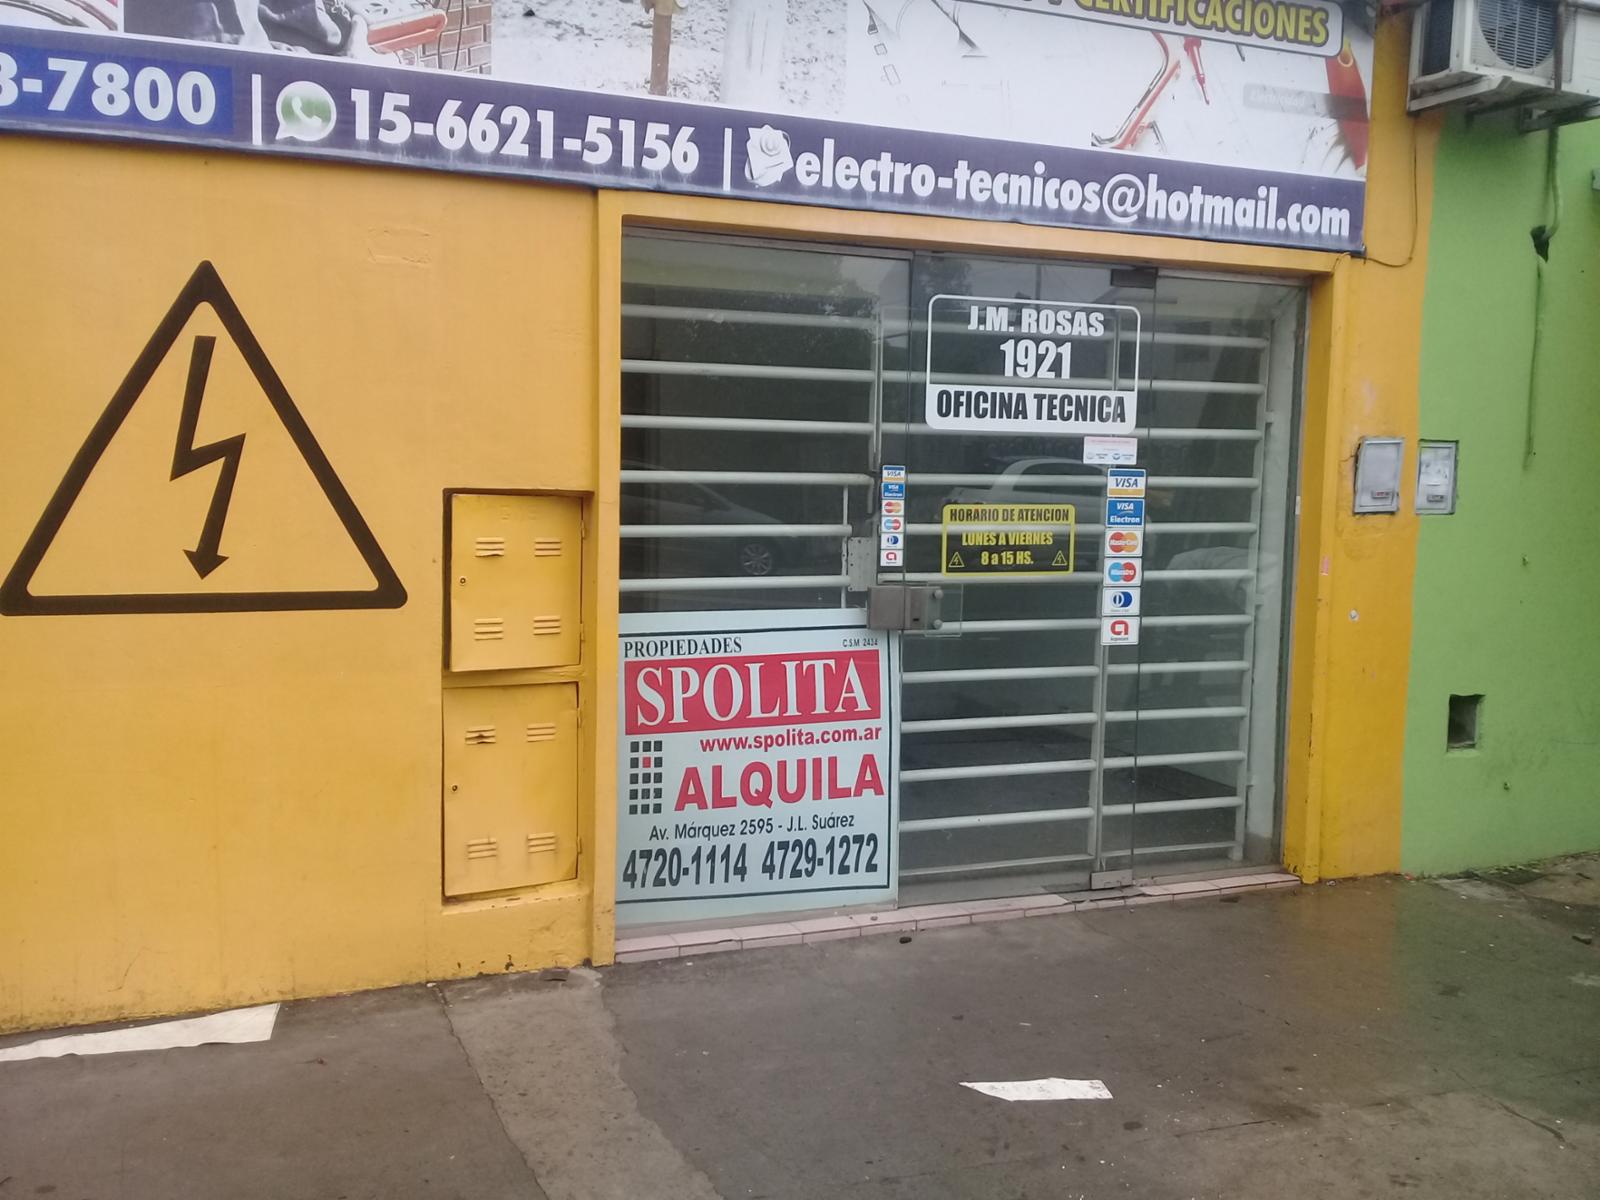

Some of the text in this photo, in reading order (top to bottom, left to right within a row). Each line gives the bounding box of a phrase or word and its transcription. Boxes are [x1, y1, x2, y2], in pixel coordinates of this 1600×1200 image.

[350, 88, 700, 175] 15-6621-5156
[795, 138, 1350, 237] electro-tecnicos@hotmail.com
[967, 305, 1105, 337] J.M. ROSAS
[1000, 339, 1072, 380] 1921
[936, 389, 1126, 423] OFICINA TECNICA
[1115, 478, 1138, 488] VISA
[950, 508, 1069, 522] HORARIO DE ATENCION
[1110, 515, 1140, 523] Electron
[1116, 502, 1134, 510] VISA
[962, 531, 1054, 546] LUNES A VIERNES
[981, 551, 1034, 565] 8 a 15 HS.
[624, 637, 742, 658] PROPIEDADES
[636, 657, 872, 727] SPOLITA
[700, 727, 882, 752] www.spolita.com.ar
[674, 753, 884, 812] ALQUILA
[649, 825, 669, 841] Av.
[674, 821, 736, 842] Márquez
[739, 818, 773, 836] 2595
[786, 815, 807, 832] J.L.
[812, 812, 855, 831] Suárez
[622, 833, 878, 889] 4720-1114 4729-1272
